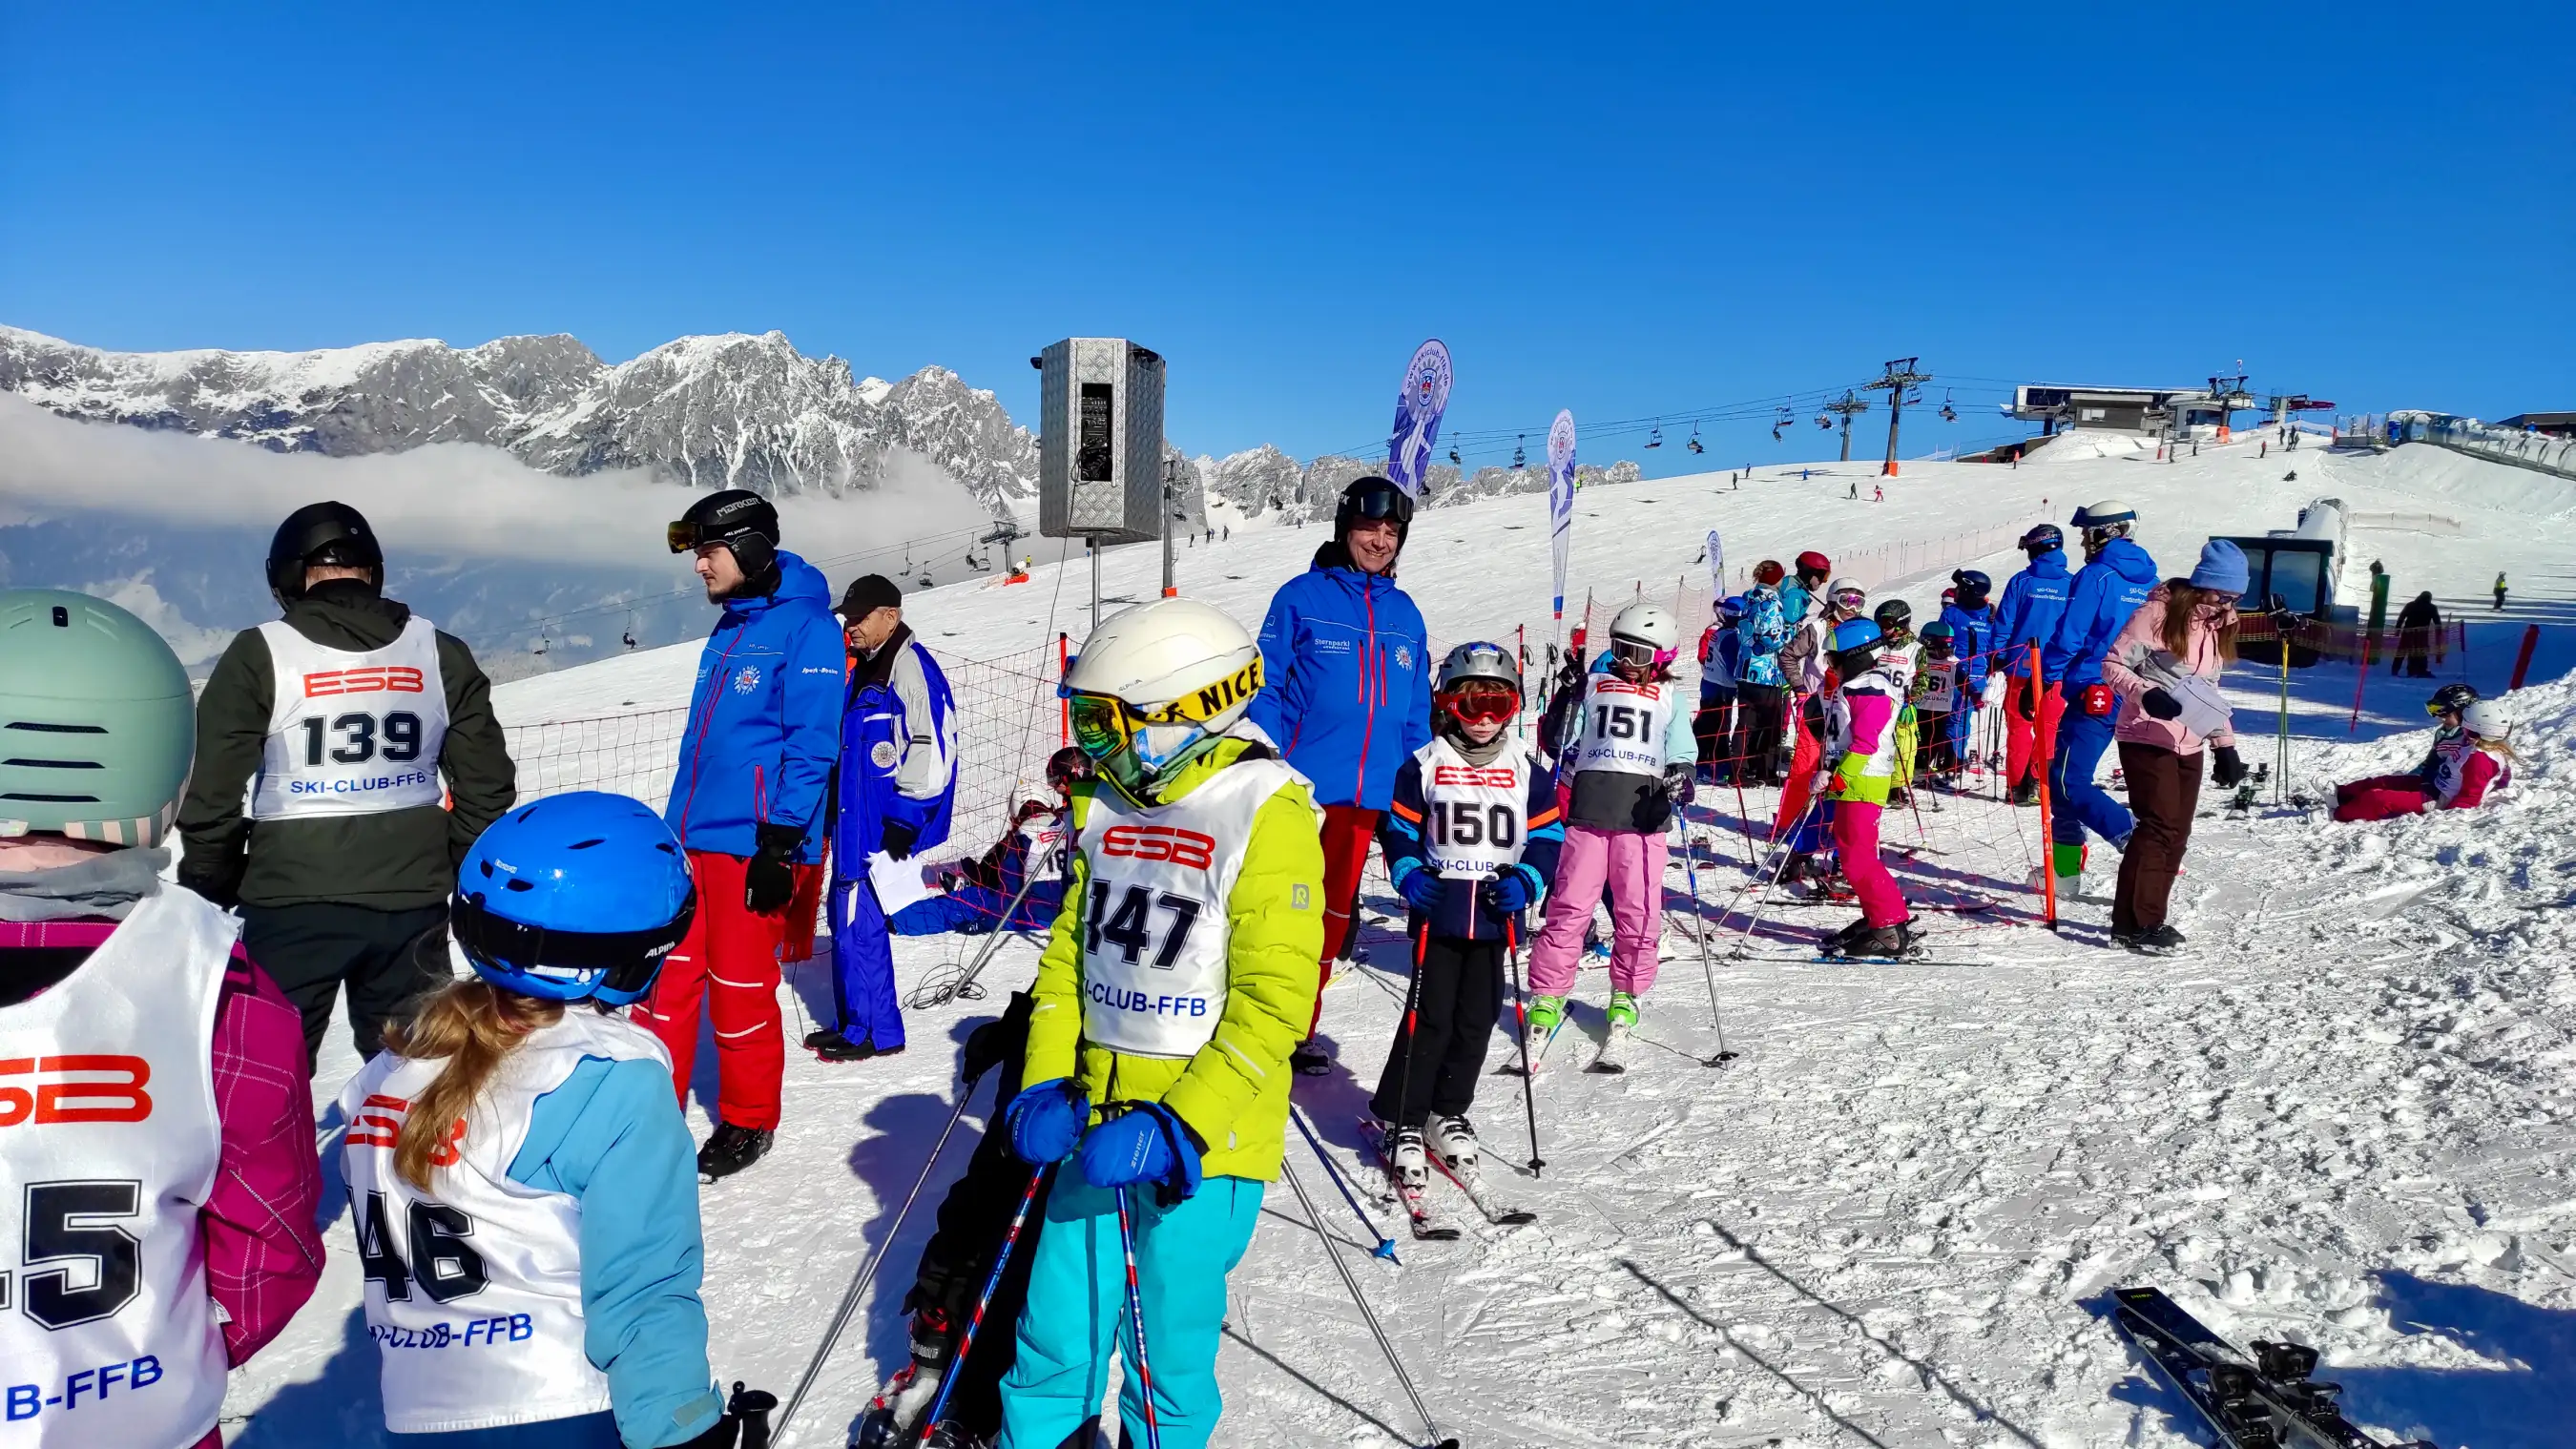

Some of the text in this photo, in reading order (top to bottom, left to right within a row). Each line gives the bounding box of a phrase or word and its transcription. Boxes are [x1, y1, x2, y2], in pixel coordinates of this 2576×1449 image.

[302, 666, 425, 698] ESB
[1197, 662, 1259, 716] NICE
[1596, 679, 1661, 702] ESB
[301, 711, 423, 767] 139
[1595, 703, 1653, 744] 151
[1434, 766, 1516, 789] ESB
[1588, 748, 1657, 766] SKI-CLUB-FFB
[290, 771, 426, 794] SKI-CLUB-FFB
[1433, 800, 1517, 850] 150
[1103, 825, 1215, 871] ESB
[1086, 878, 1205, 971] 147
[1084, 978, 1207, 1017] I-CLUB-FFB
[0, 1179, 142, 1332] 5
